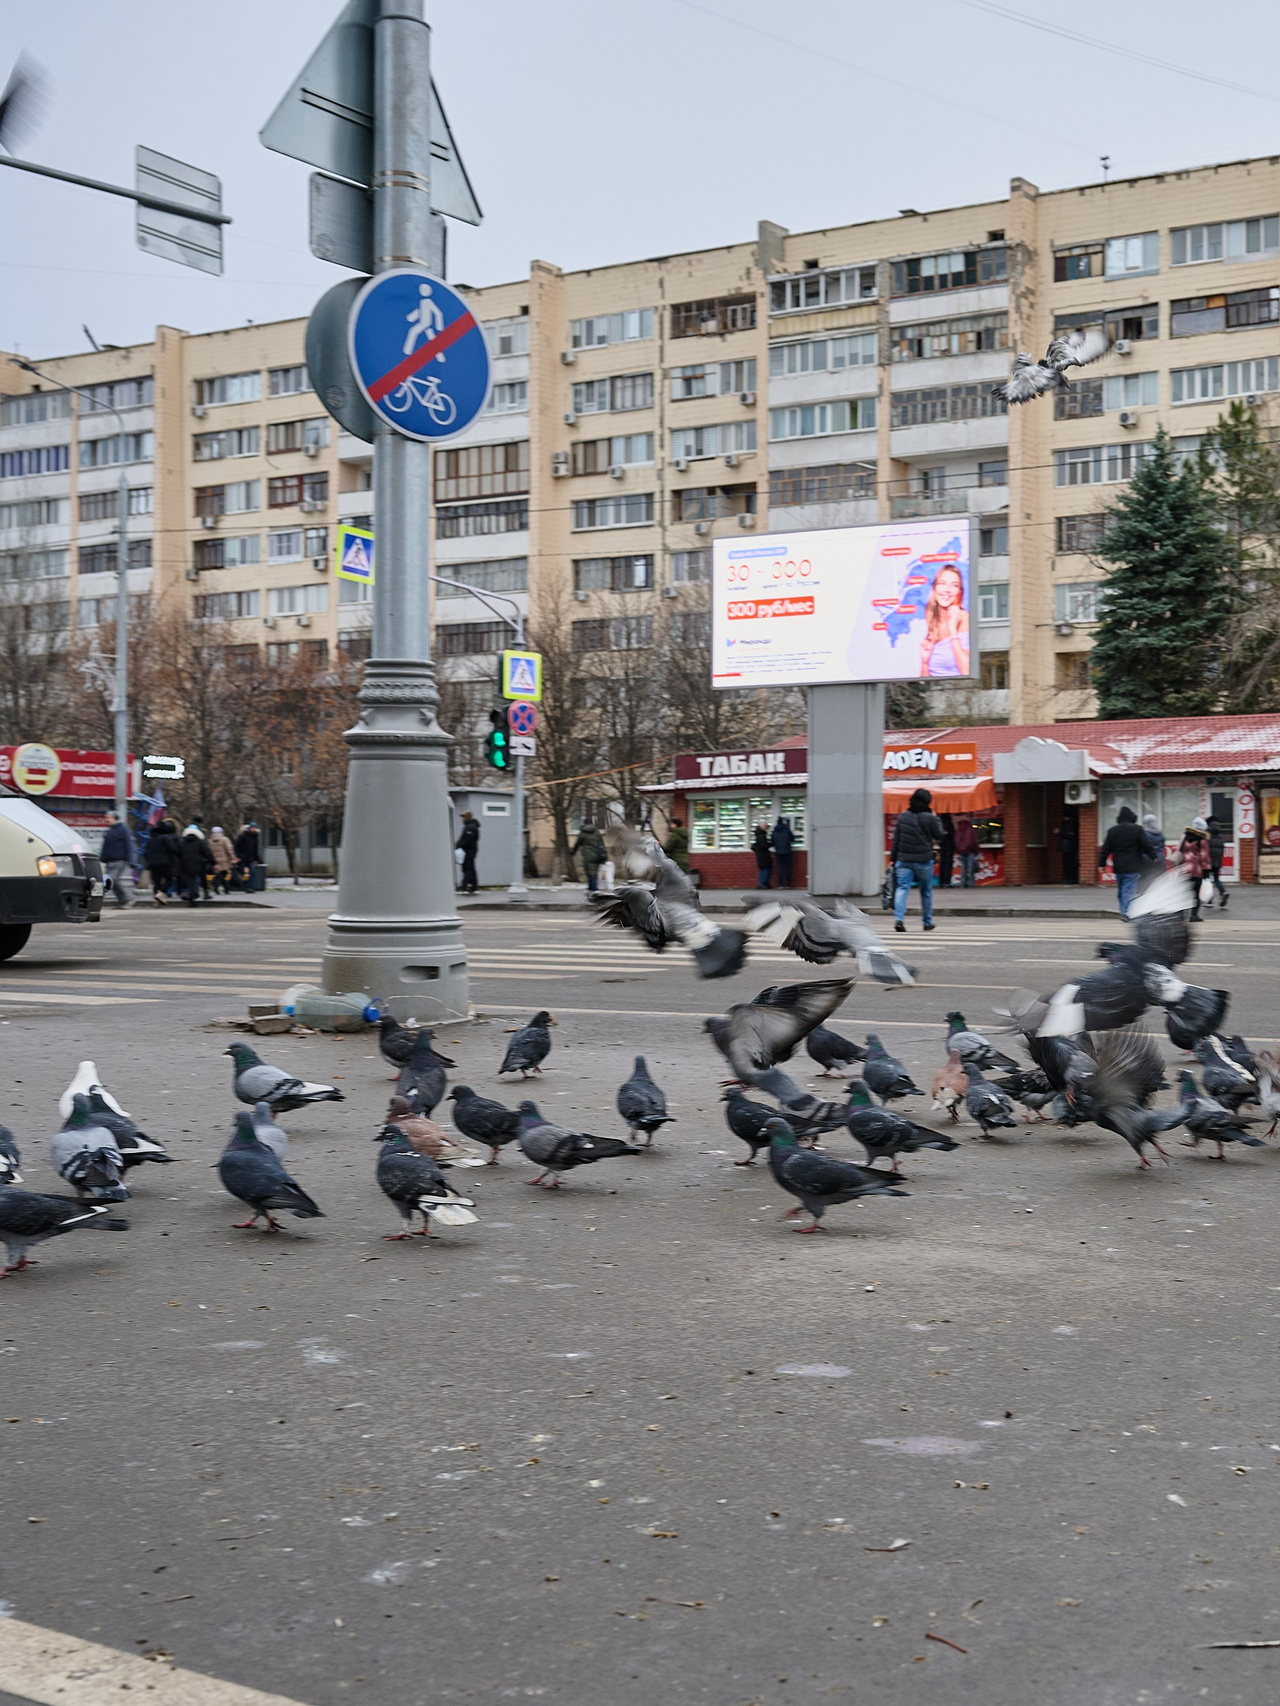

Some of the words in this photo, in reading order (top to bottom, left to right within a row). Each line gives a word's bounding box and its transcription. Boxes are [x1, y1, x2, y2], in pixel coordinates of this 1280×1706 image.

[727, 565, 750, 582] 30
[727, 602, 756, 618] 300
[757, 600, 813, 618] руб/мес
[696, 752, 786, 777] ТАБАК
